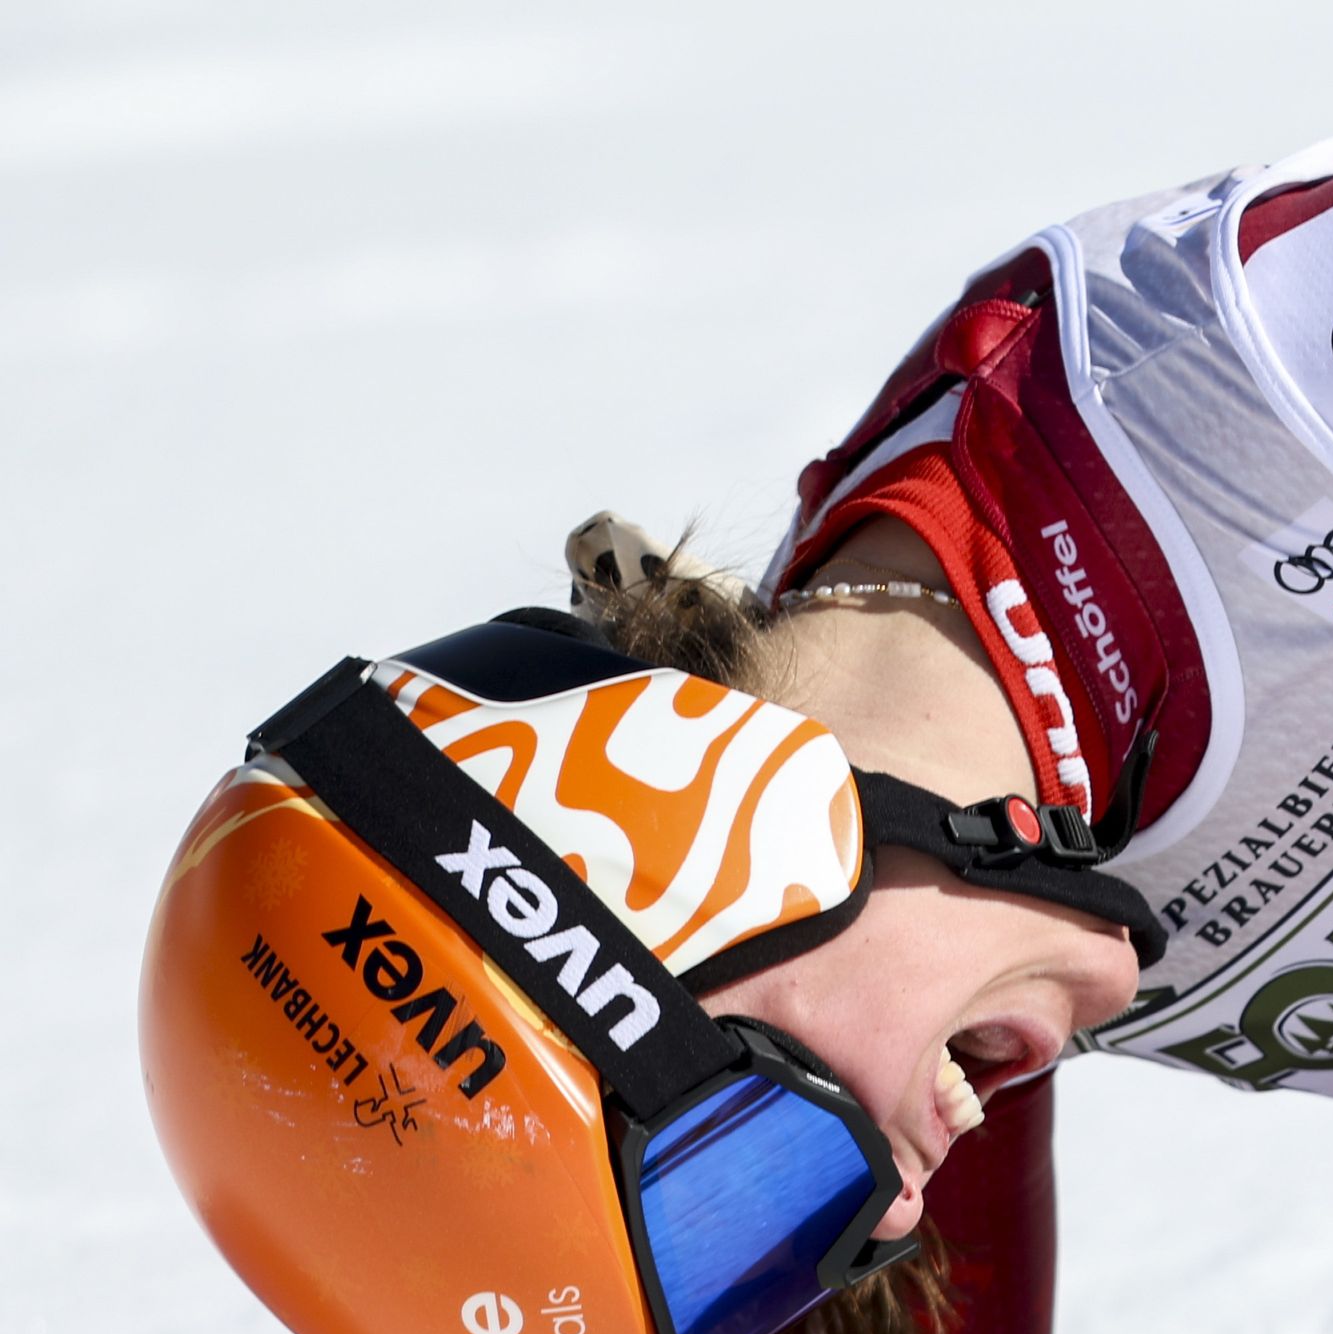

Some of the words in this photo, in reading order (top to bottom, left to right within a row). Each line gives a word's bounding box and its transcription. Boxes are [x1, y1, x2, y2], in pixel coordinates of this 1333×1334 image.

[240, 933, 369, 1087] LECHBANK
[321, 893, 507, 1100] uvex
[434, 818, 661, 1053] uvex
